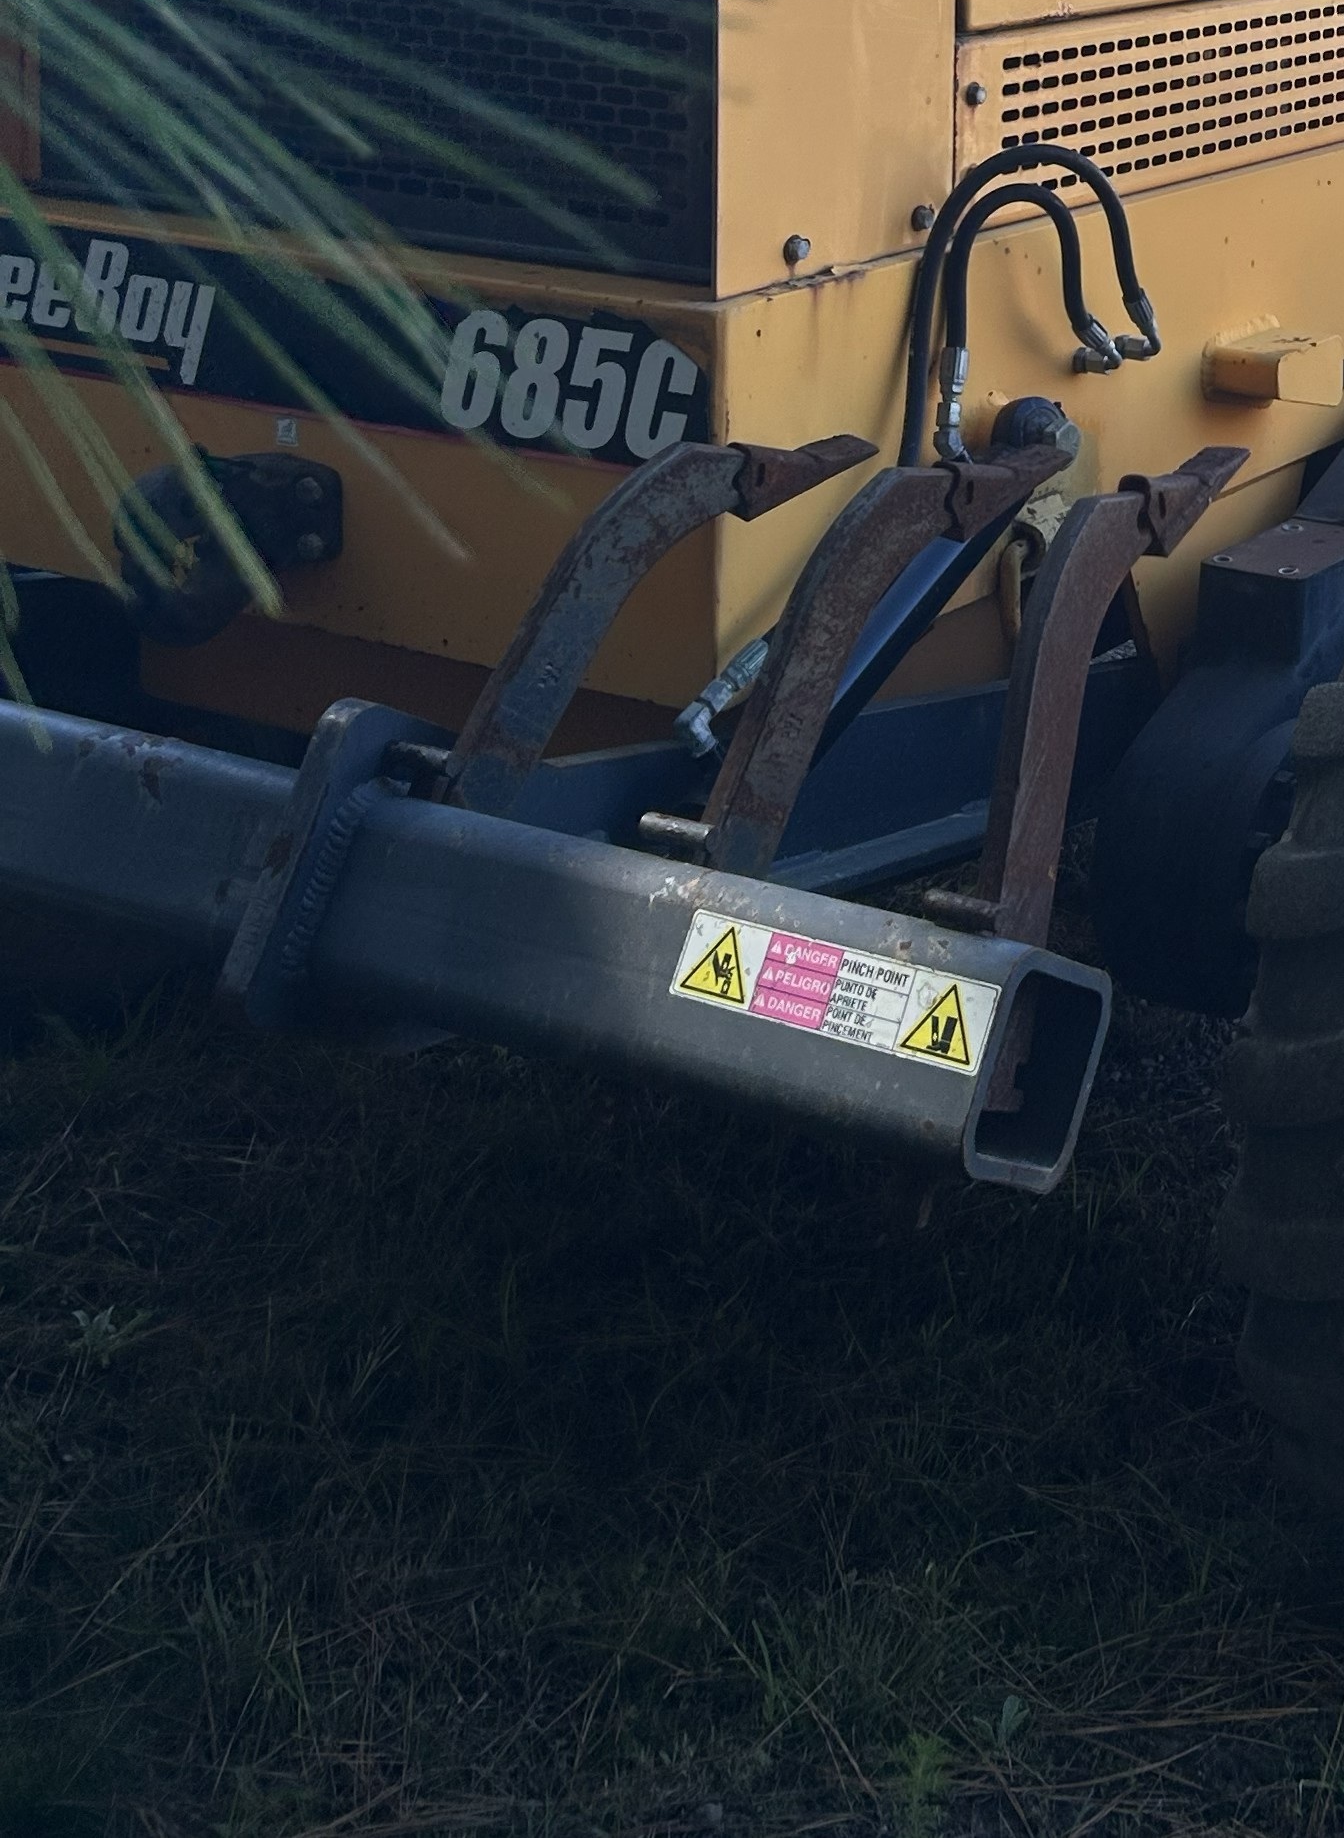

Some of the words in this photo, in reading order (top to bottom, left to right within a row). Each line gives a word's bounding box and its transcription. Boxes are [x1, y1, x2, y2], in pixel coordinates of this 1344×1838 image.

[0, 238, 216, 386] eeBoy
[440, 308, 700, 460] 685C
[783, 942, 839, 969] DANGER
[774, 971, 831, 996] PELIGRO
[840, 958, 873, 978] PINCH
[875, 967, 910, 987] POINT
[834, 978, 865, 997] PUNTO
[865, 986, 878, 1000] DE
[767, 997, 822, 1021] DANGER
[829, 992, 869, 1012] APRIETE
[826, 1006, 853, 1023] POINT
[853, 1013, 866, 1027] DE
[822, 1021, 874, 1042] PINCEMENT
